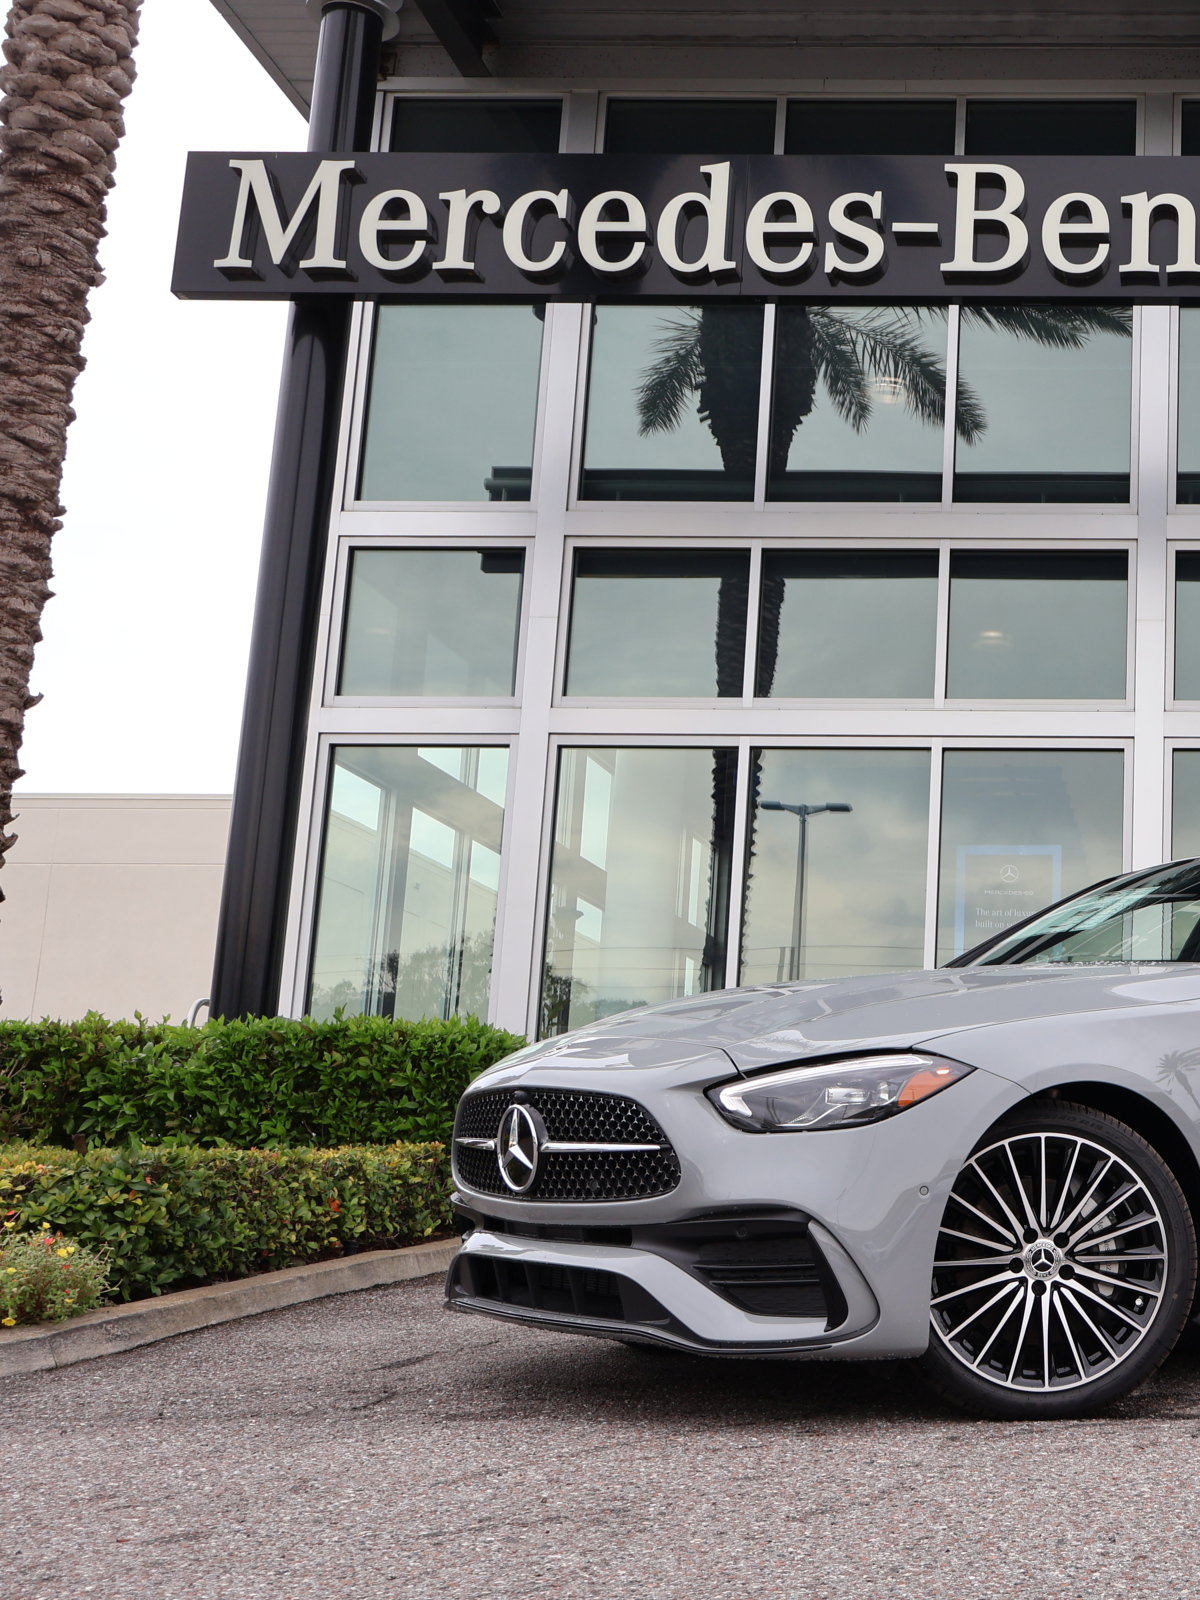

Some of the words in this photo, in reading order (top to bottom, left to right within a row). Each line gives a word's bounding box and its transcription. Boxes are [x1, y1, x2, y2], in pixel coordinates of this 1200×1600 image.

[976, 907, 990, 917] The
[991, 909, 1003, 917] art
[1004, 908, 1013, 917] of
[975, 919, 993, 928] built
